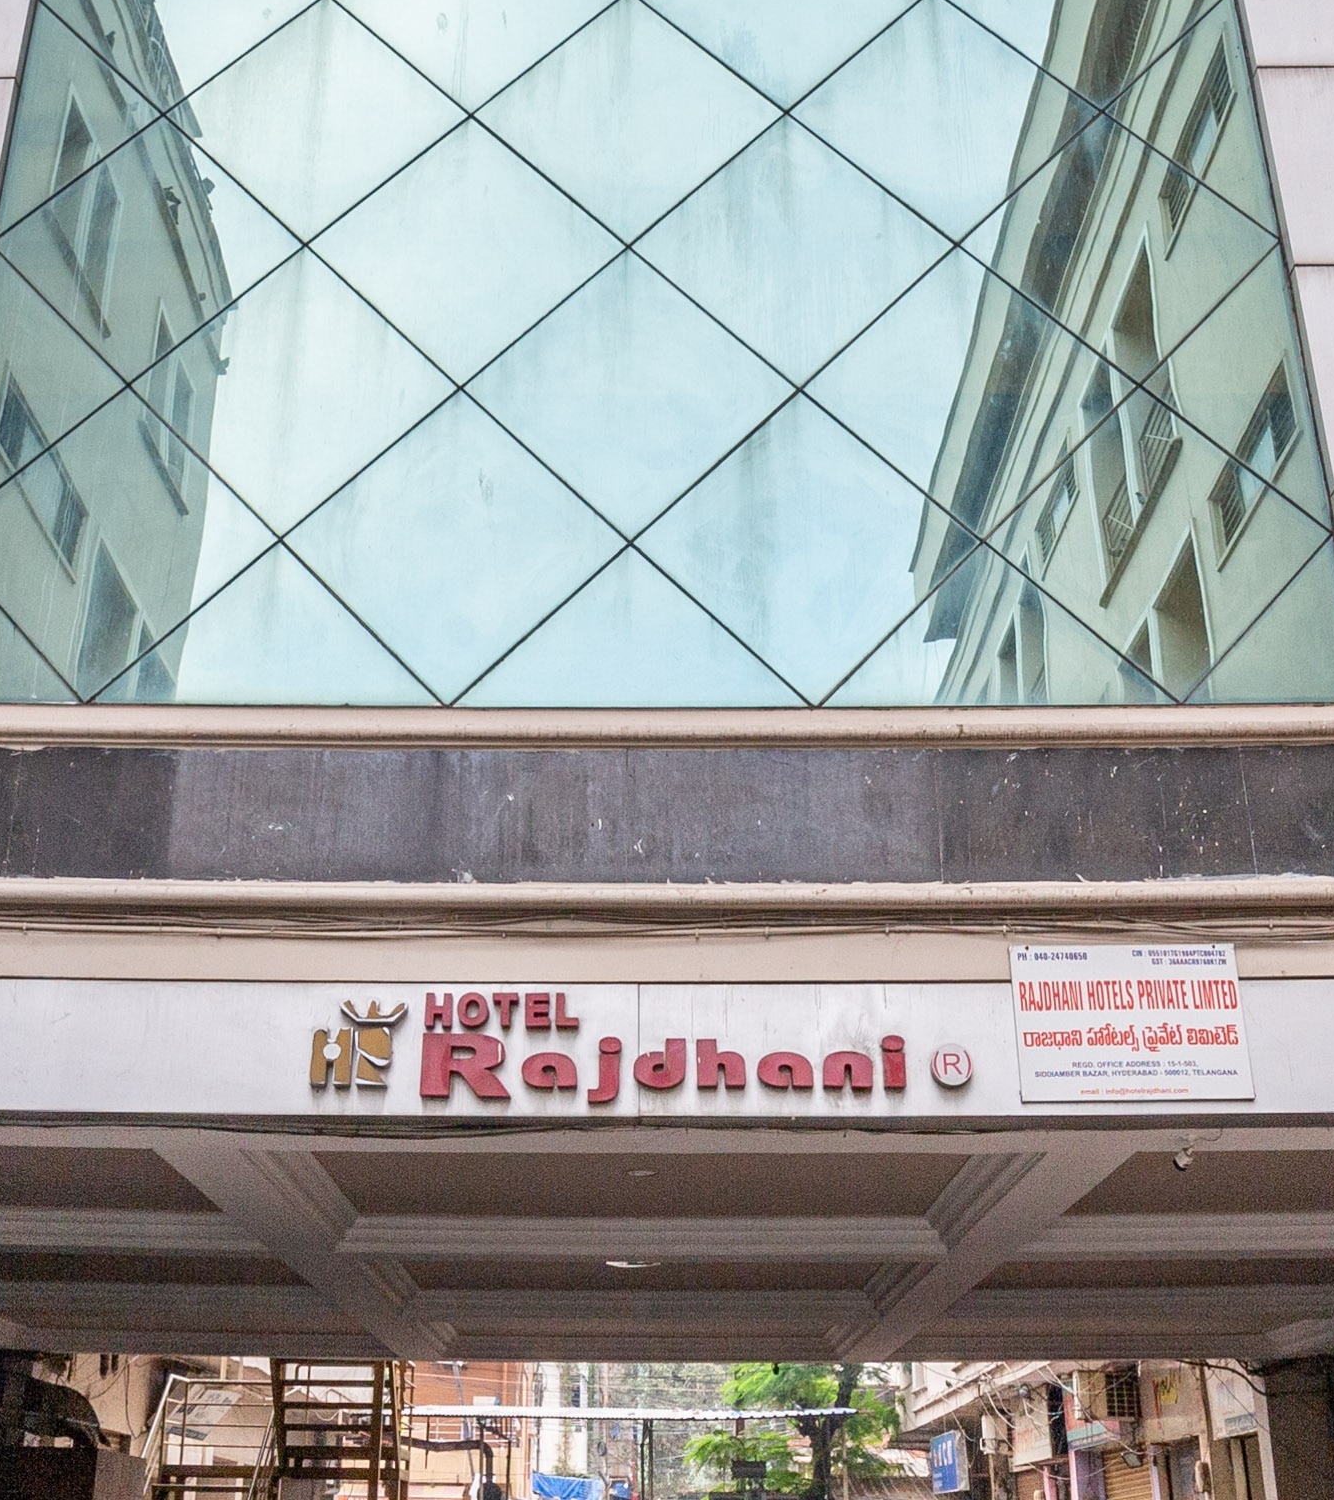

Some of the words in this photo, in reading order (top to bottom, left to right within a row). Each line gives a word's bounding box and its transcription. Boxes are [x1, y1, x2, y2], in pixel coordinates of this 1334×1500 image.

[1017, 952, 1028, 961] PH
[1034, 952, 1087, 961] 040-24740650
[424, 991, 579, 1029] HOTEL
[1018, 981, 1084, 1011] RAJDHANI
[1086, 980, 1134, 1011] HOTELS
[1137, 979, 1189, 1010] PRIVATE
[1190, 979, 1238, 1010] LIMTED
[1023, 1029, 1083, 1050] రాజధాని
[1142, 1022, 1183, 1052] ప్రైవేట్
[1186, 1024, 1239, 1046] లిమిటెడ్
[420, 1032, 907, 1103] Rajdhani
[1035, 1070, 1080, 1078] SIDDIAMBER
[1082, 1070, 1110, 1078] BAZAR,
[1111, 1069, 1158, 1077] HYDERABAD
[1164, 1069, 1191, 1077] 500012,
[1193, 1068, 1238, 1077] TELANGANA
[1072, 1061, 1096, 1069] REGD.
